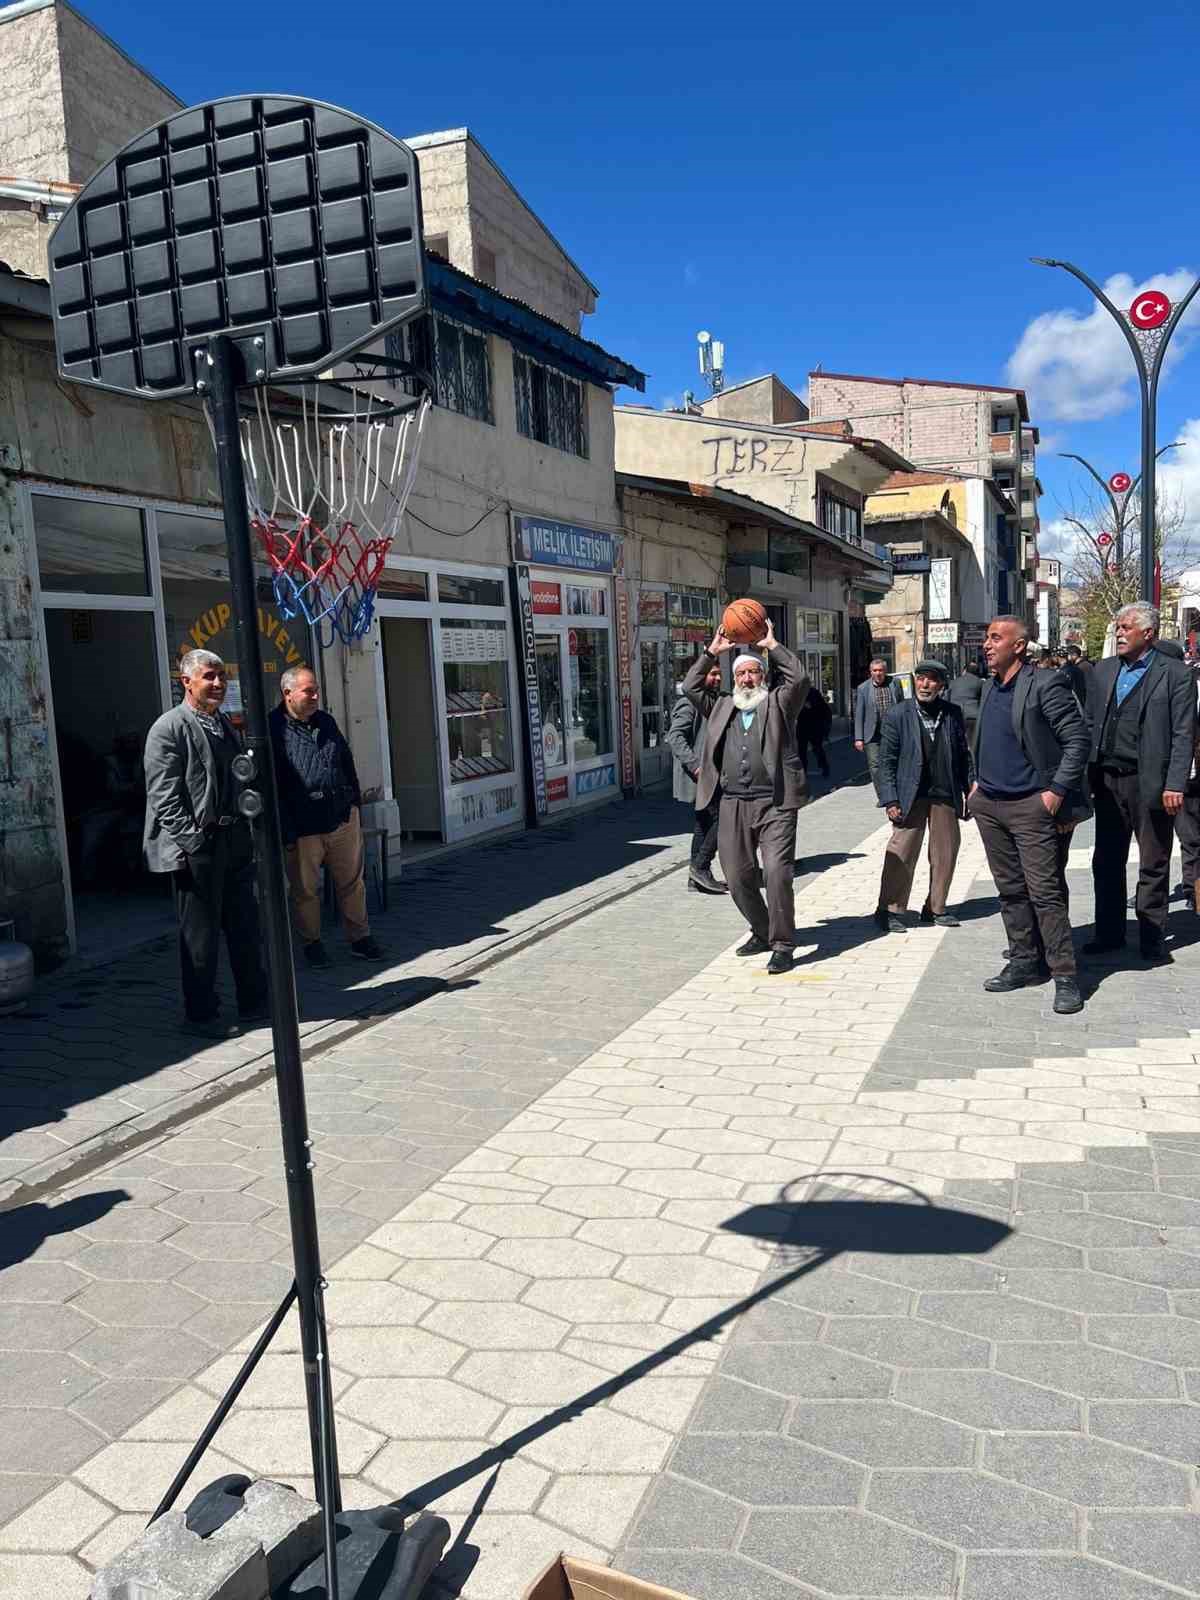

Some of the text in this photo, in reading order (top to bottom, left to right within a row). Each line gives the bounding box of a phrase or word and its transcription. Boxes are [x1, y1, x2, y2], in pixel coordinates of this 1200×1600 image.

[533, 526, 569, 555] MELİK
[570, 528, 614, 562] İLETİŞİM
[533, 592, 560, 604] vodafone
[528, 688, 548, 814] SAMSUNG
[578, 766, 614, 793] KVK
